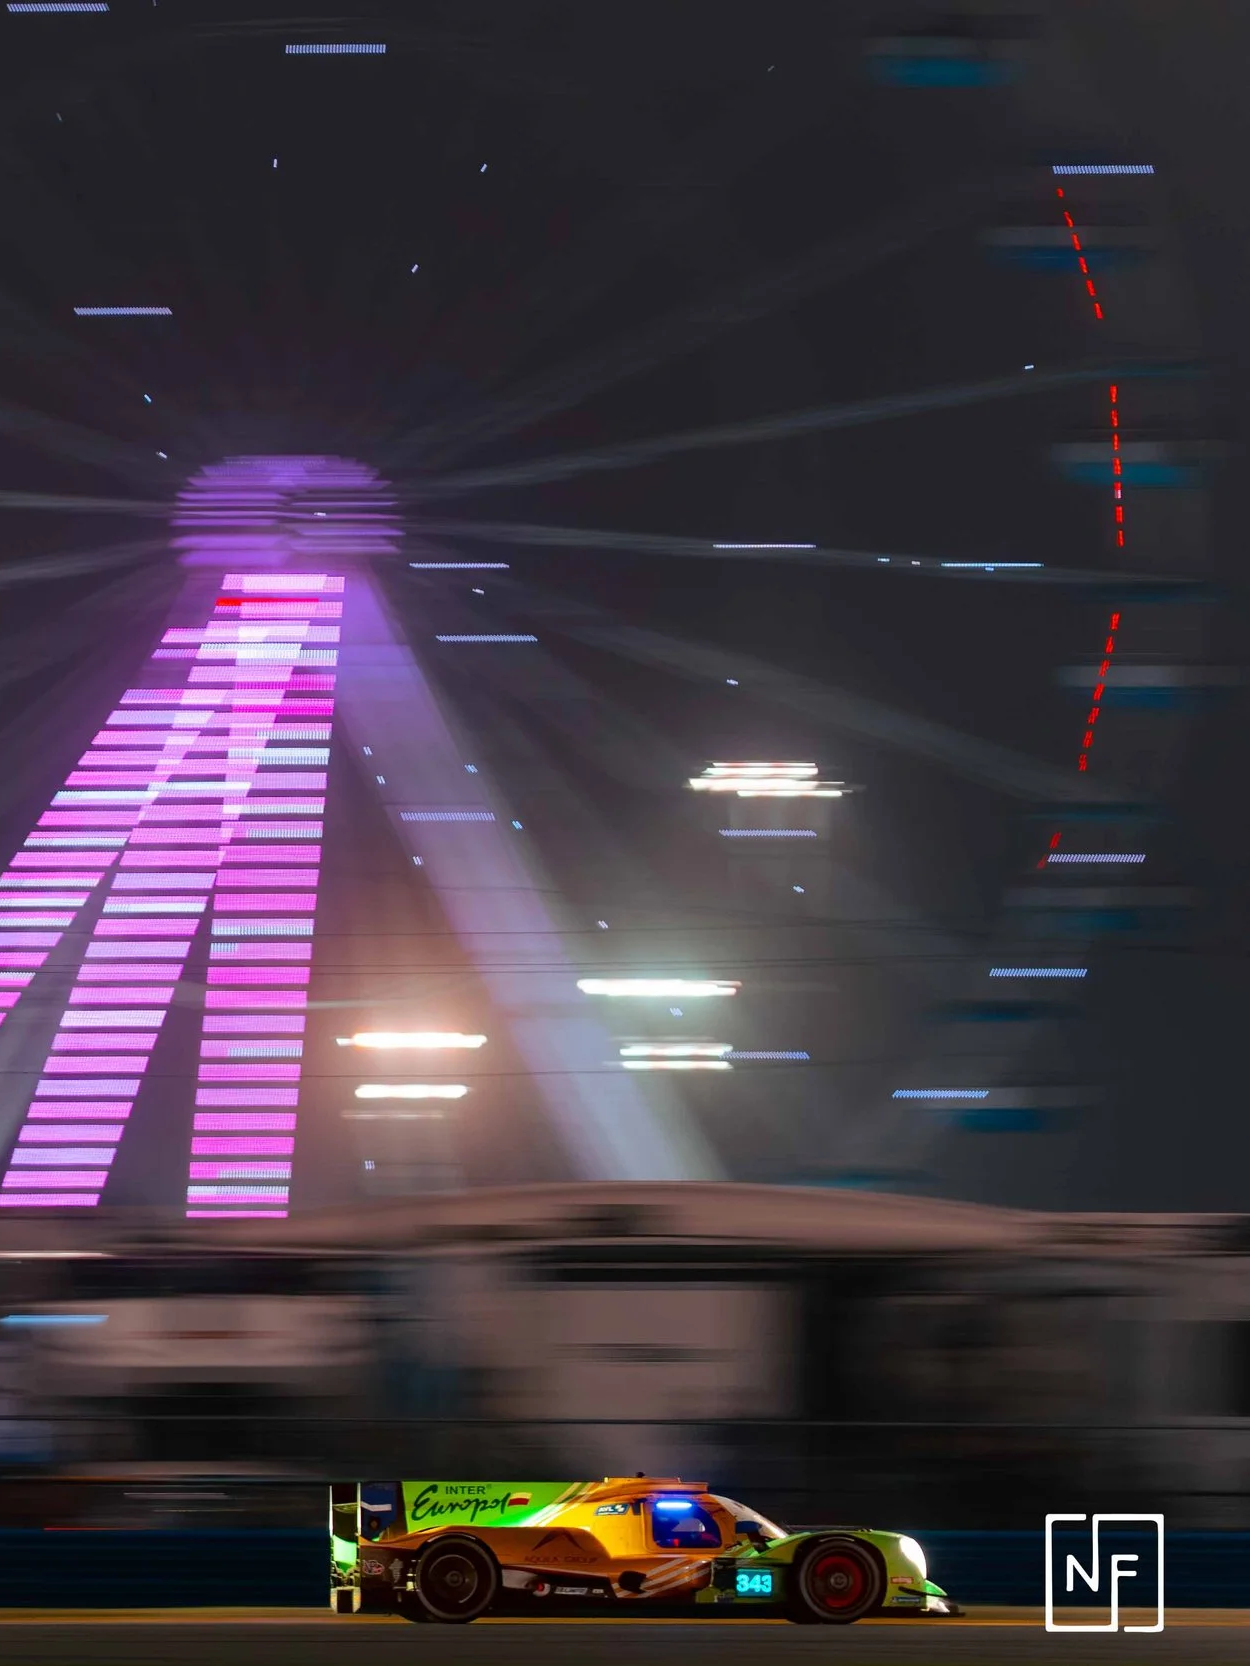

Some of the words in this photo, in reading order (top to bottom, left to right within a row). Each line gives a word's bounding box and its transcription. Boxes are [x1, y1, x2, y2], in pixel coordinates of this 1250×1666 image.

[445, 1485, 486, 1495] INTER
[411, 1484, 511, 1522] Europol
[736, 1573, 772, 1593] 343
